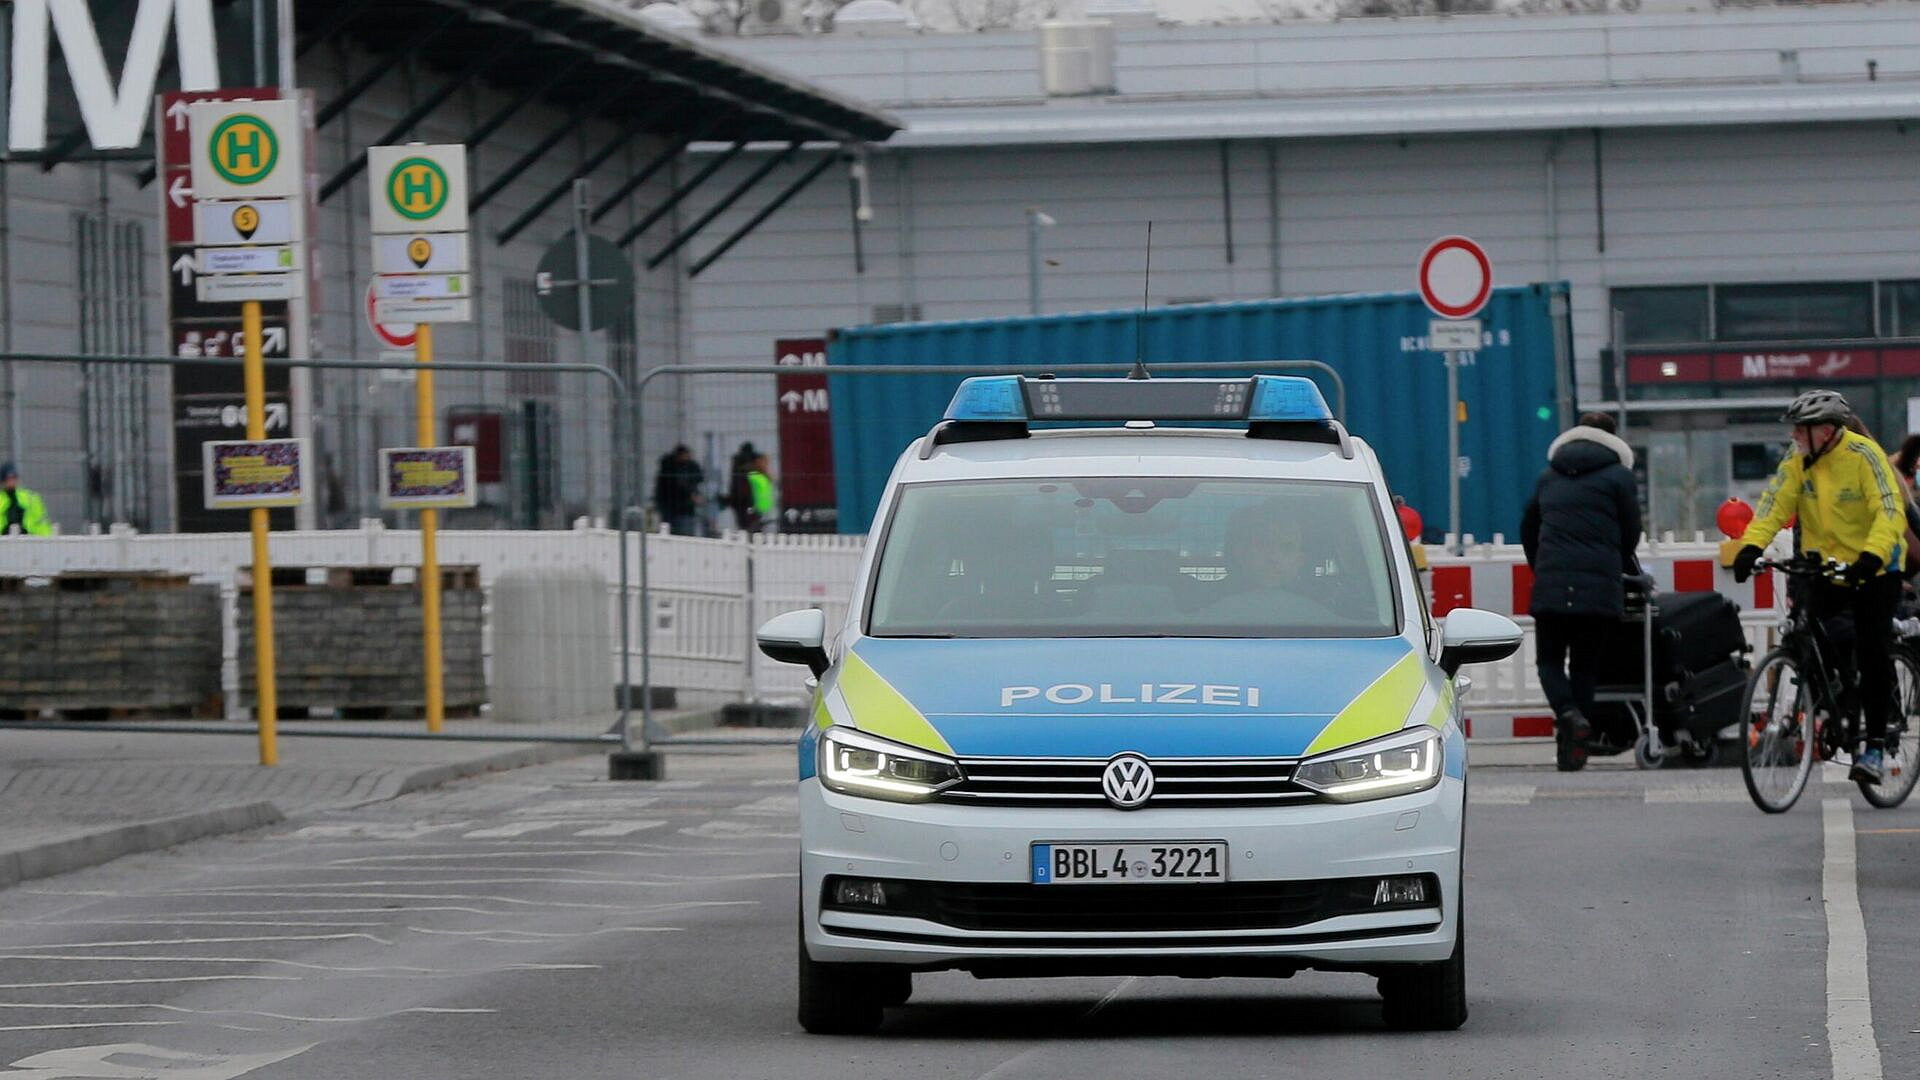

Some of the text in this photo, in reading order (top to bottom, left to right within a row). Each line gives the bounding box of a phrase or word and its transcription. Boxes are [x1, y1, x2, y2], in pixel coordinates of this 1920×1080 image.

[8, 0, 220, 151] M
[228, 131, 260, 168] H
[403, 172, 433, 205] H
[803, 389, 829, 412] M
[1001, 683, 1259, 708] POLIZEI
[1104, 758, 1153, 805] VW
[1151, 848, 1220, 878] 3221
